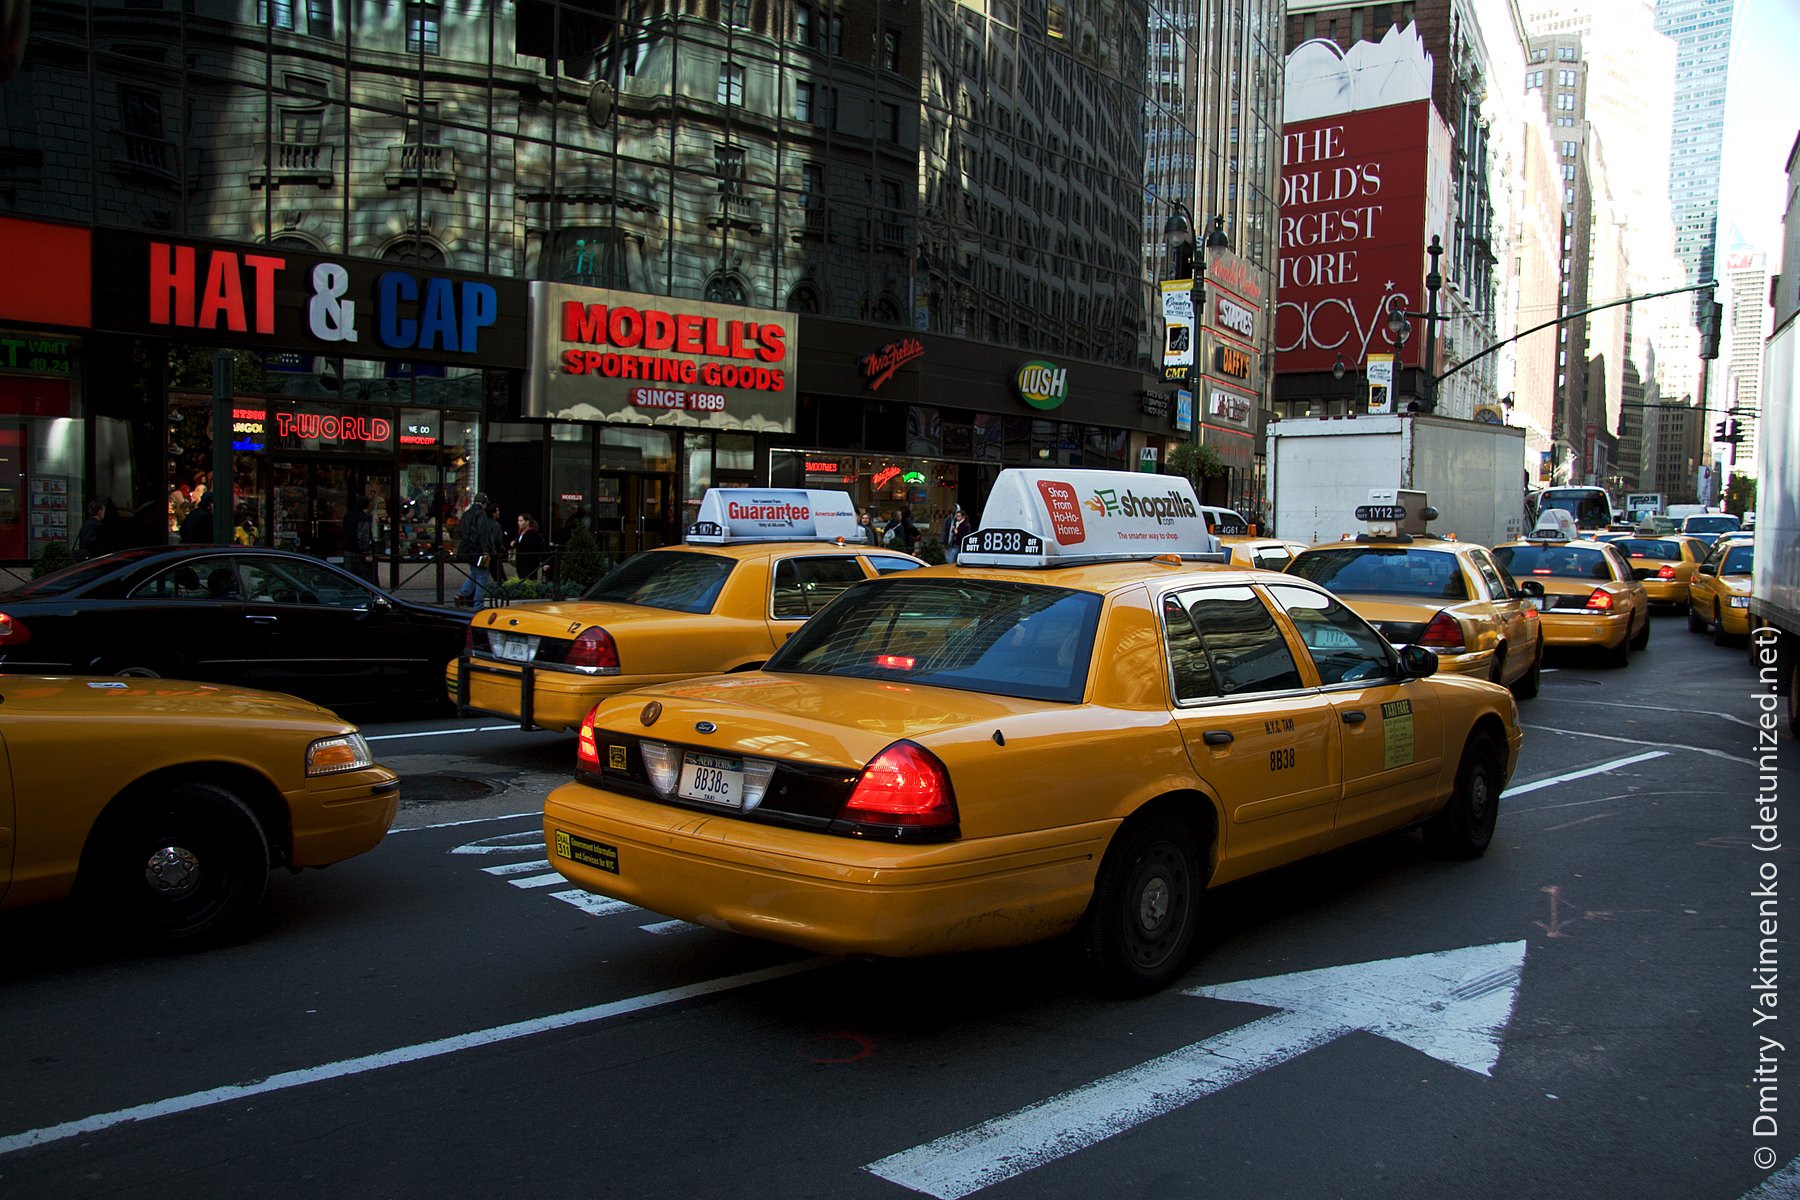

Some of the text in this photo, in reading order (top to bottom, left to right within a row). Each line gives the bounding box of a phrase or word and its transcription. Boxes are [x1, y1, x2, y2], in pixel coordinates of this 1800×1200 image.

[1282, 126, 1346, 166] THE
[1280, 162, 1382, 209] RLD'S
[1279, 205, 1384, 249] RGEST
[1279, 250, 1359, 290] TORE
[149, 242, 497, 354] HAT & CAP
[1219, 299, 1254, 338] STAPLES
[562, 301, 787, 363] MODELL'S
[28, 339, 70, 355] WMT
[562, 349, 786, 392] SPORTING GOODS
[1165, 367, 1188, 379] CMT
[1022, 367, 1067, 398] LUSH
[636, 388, 726, 411] SINCE 1889
[276, 412, 391, 442] T-WORLD
[408, 425, 430, 434] WE DO
[805, 462, 838, 472] SMOOTHIES
[1048, 487, 1069, 500] Shop
[728, 502, 810, 521] Guarantee
[1053, 499, 1074, 510] From
[1120, 489, 1198, 526] shopzilla
[1369, 507, 1394, 519] 1Y12
[1053, 512, 1080, 522] Ho-Ho-
[1057, 524, 1083, 535] Home.
[1117, 531, 1128, 540] The
[1128, 532, 1147, 540] smarter
[1148, 533, 1159, 541] way
[1159, 532, 1166, 540] to
[966, 544, 980, 552] DUTY
[968, 537, 979, 545] OFF
[984, 532, 1021, 551] 8B38
[1025, 545, 1039, 553] DUTY
[1027, 538, 1038, 546] OFF
[567, 621, 582, 634] 12
[1384, 700, 1411, 719] TAXI FARE
[1281, 717, 1295, 732] TAXI
[699, 755, 733, 770] NEW YORK
[1270, 747, 1295, 772] 8B38
[557, 832, 570, 845] DIAL
[557, 841, 571, 858] 311
[571, 837, 617, 859] Government Information
[575, 851, 583, 860] and
[583, 854, 600, 865] Services
[605, 860, 615, 871] NYC
